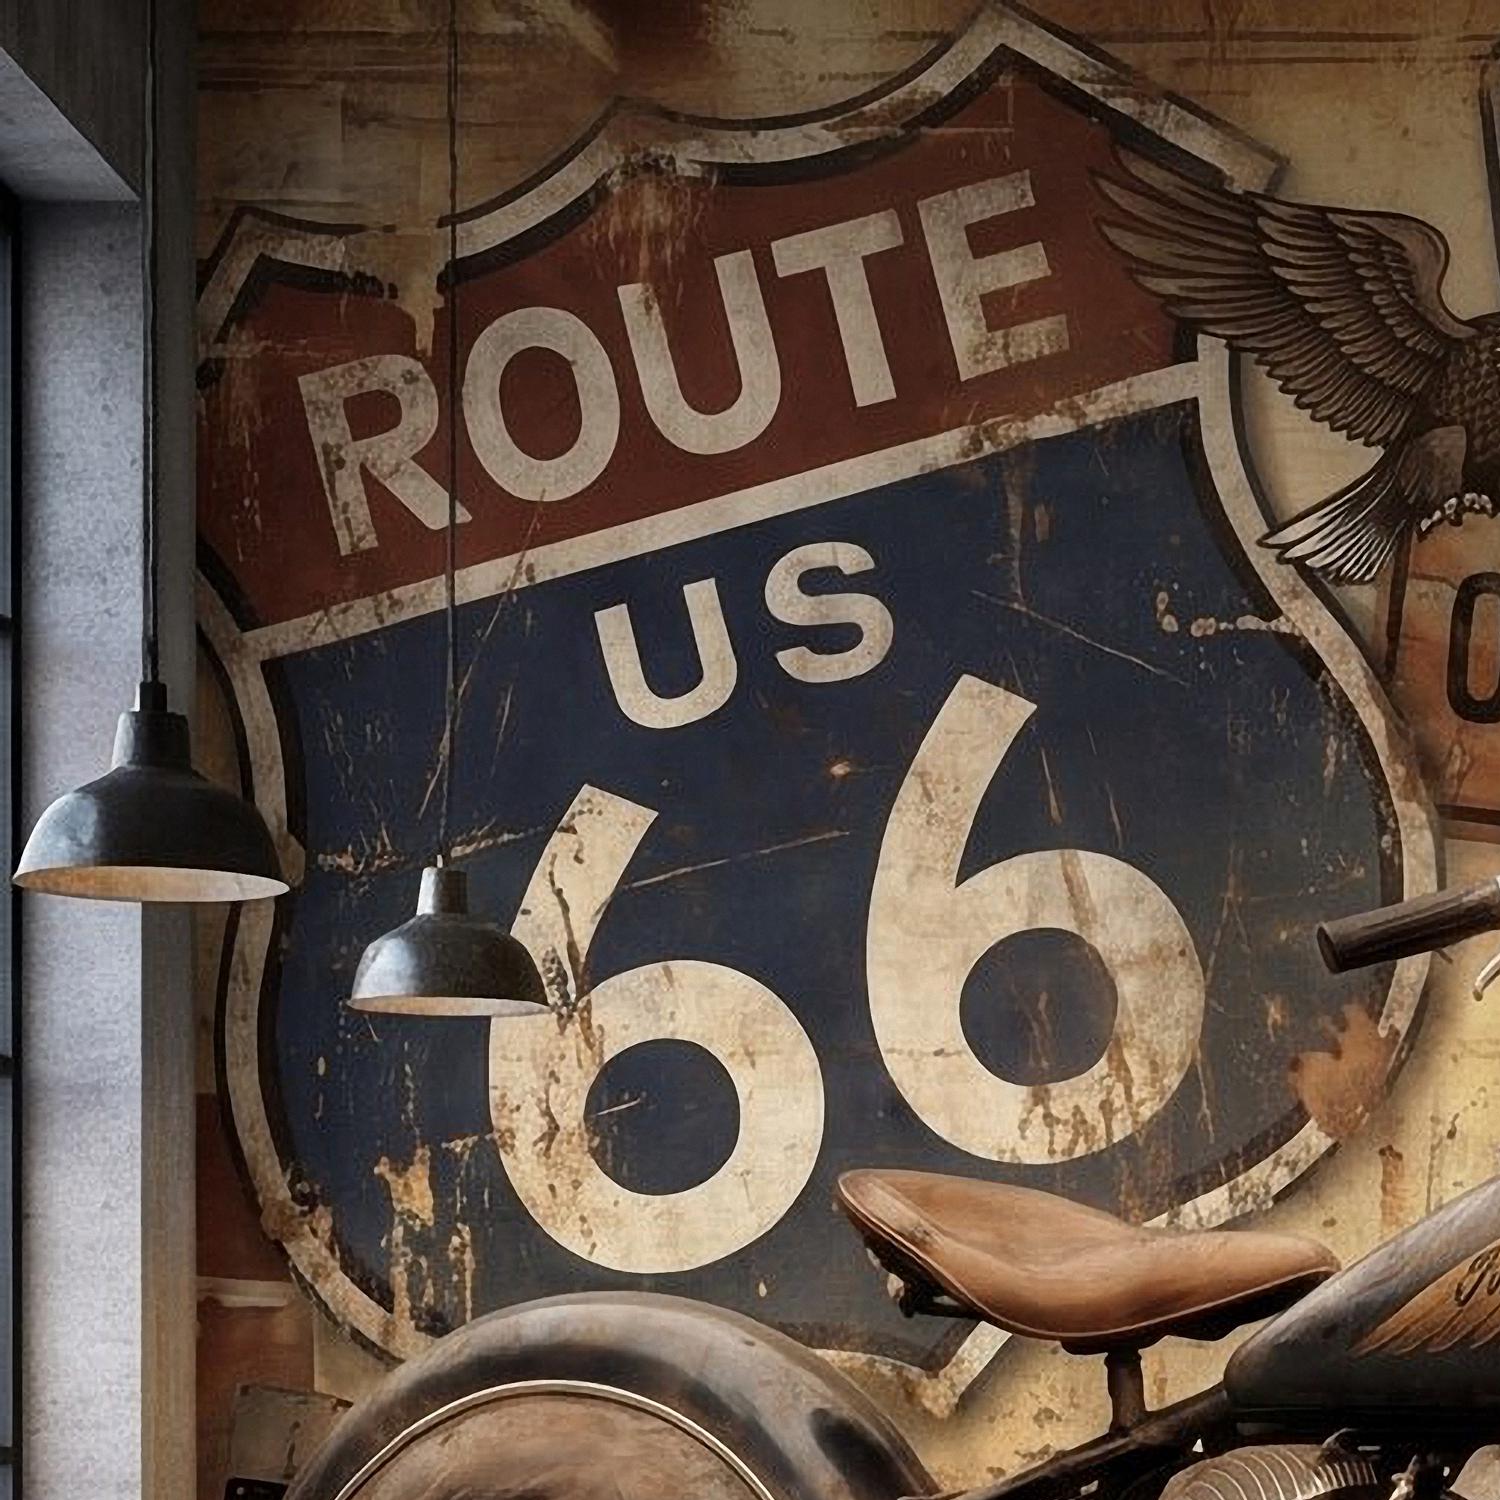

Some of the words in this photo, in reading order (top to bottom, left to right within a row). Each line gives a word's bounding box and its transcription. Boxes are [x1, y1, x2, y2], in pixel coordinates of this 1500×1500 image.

[297, 169, 1072, 557] ROUTE
[593, 540, 895, 730] US
[487, 673, 1205, 1275] 66
